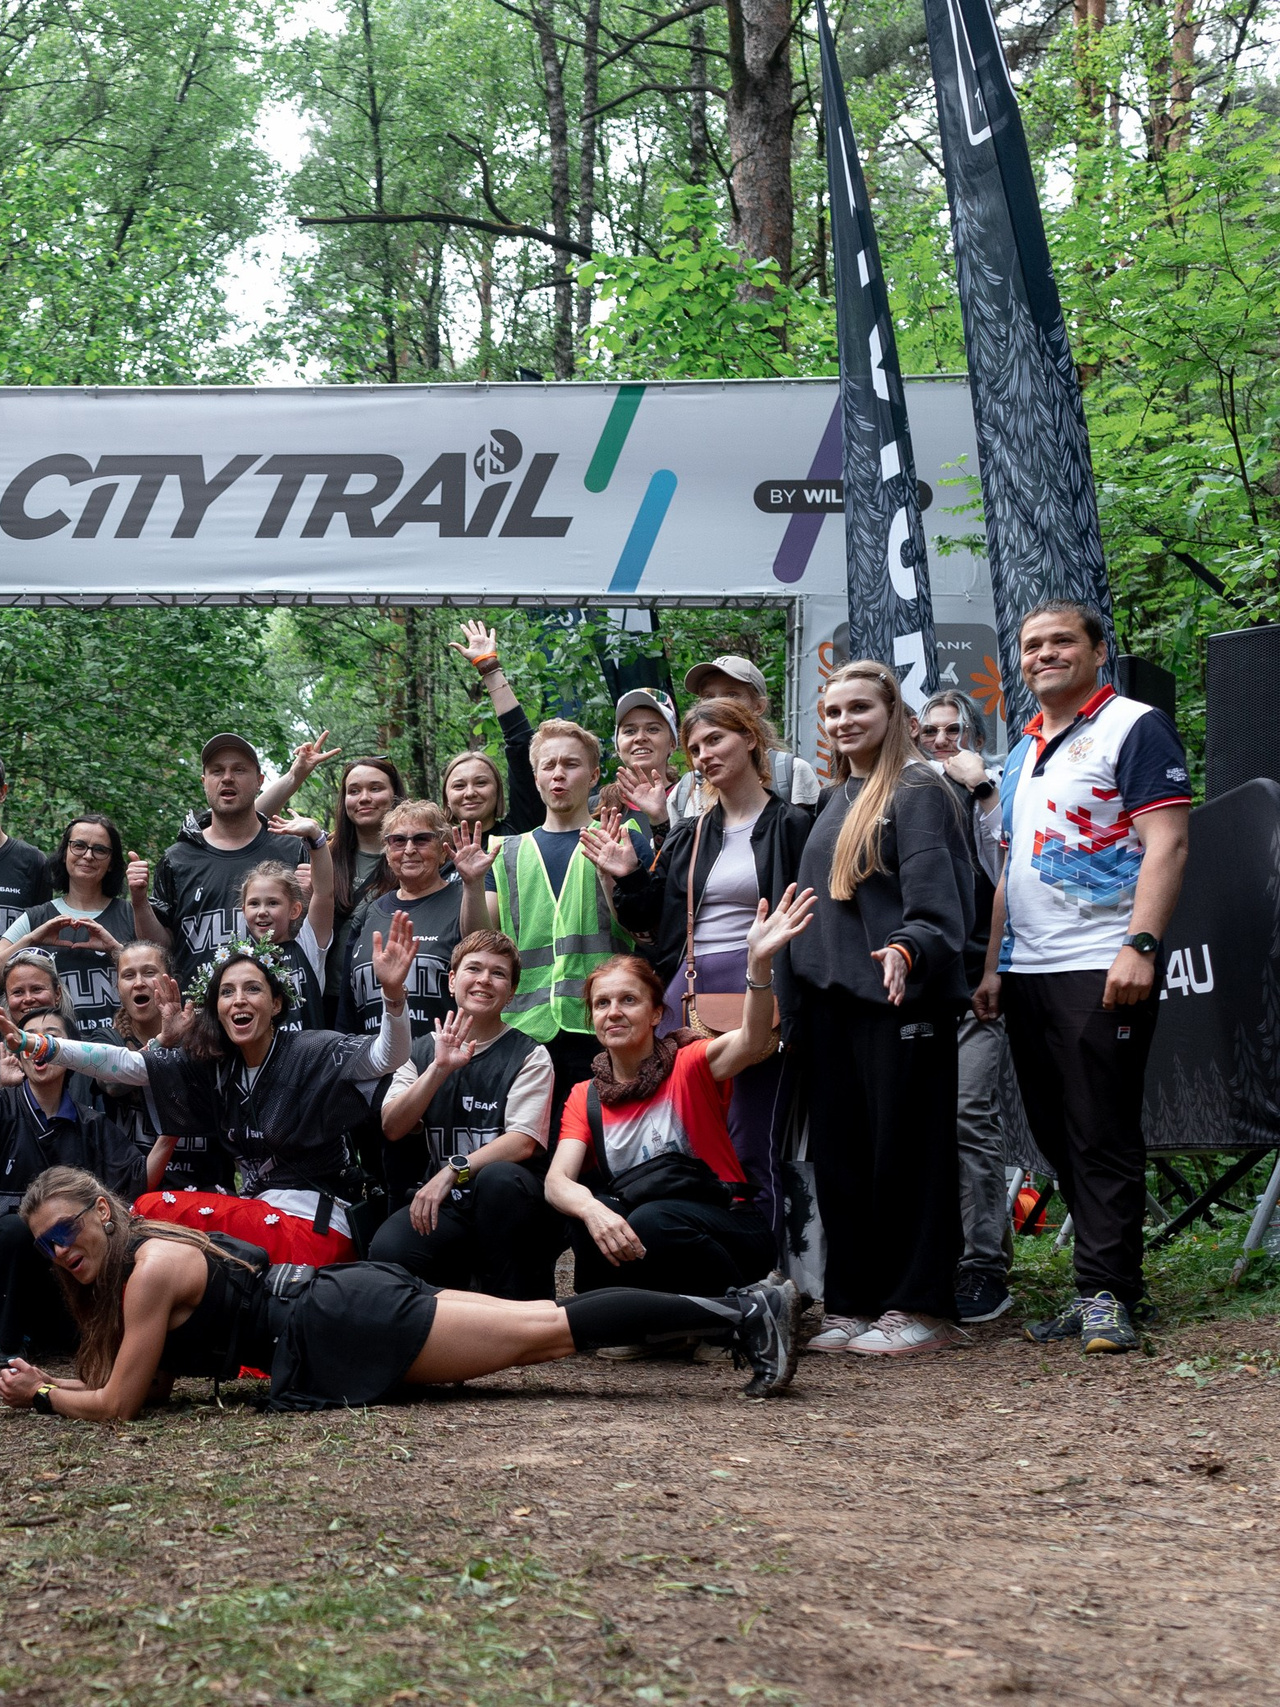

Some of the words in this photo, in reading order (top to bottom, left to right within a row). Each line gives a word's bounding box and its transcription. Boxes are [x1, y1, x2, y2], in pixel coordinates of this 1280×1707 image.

[770, 489, 796, 503] BY
[803, 489, 844, 503] WIL
[936, 641, 972, 650] ANK
[409, 1010, 428, 1021] AIL
[165, 1161, 195, 1172] RAIL
